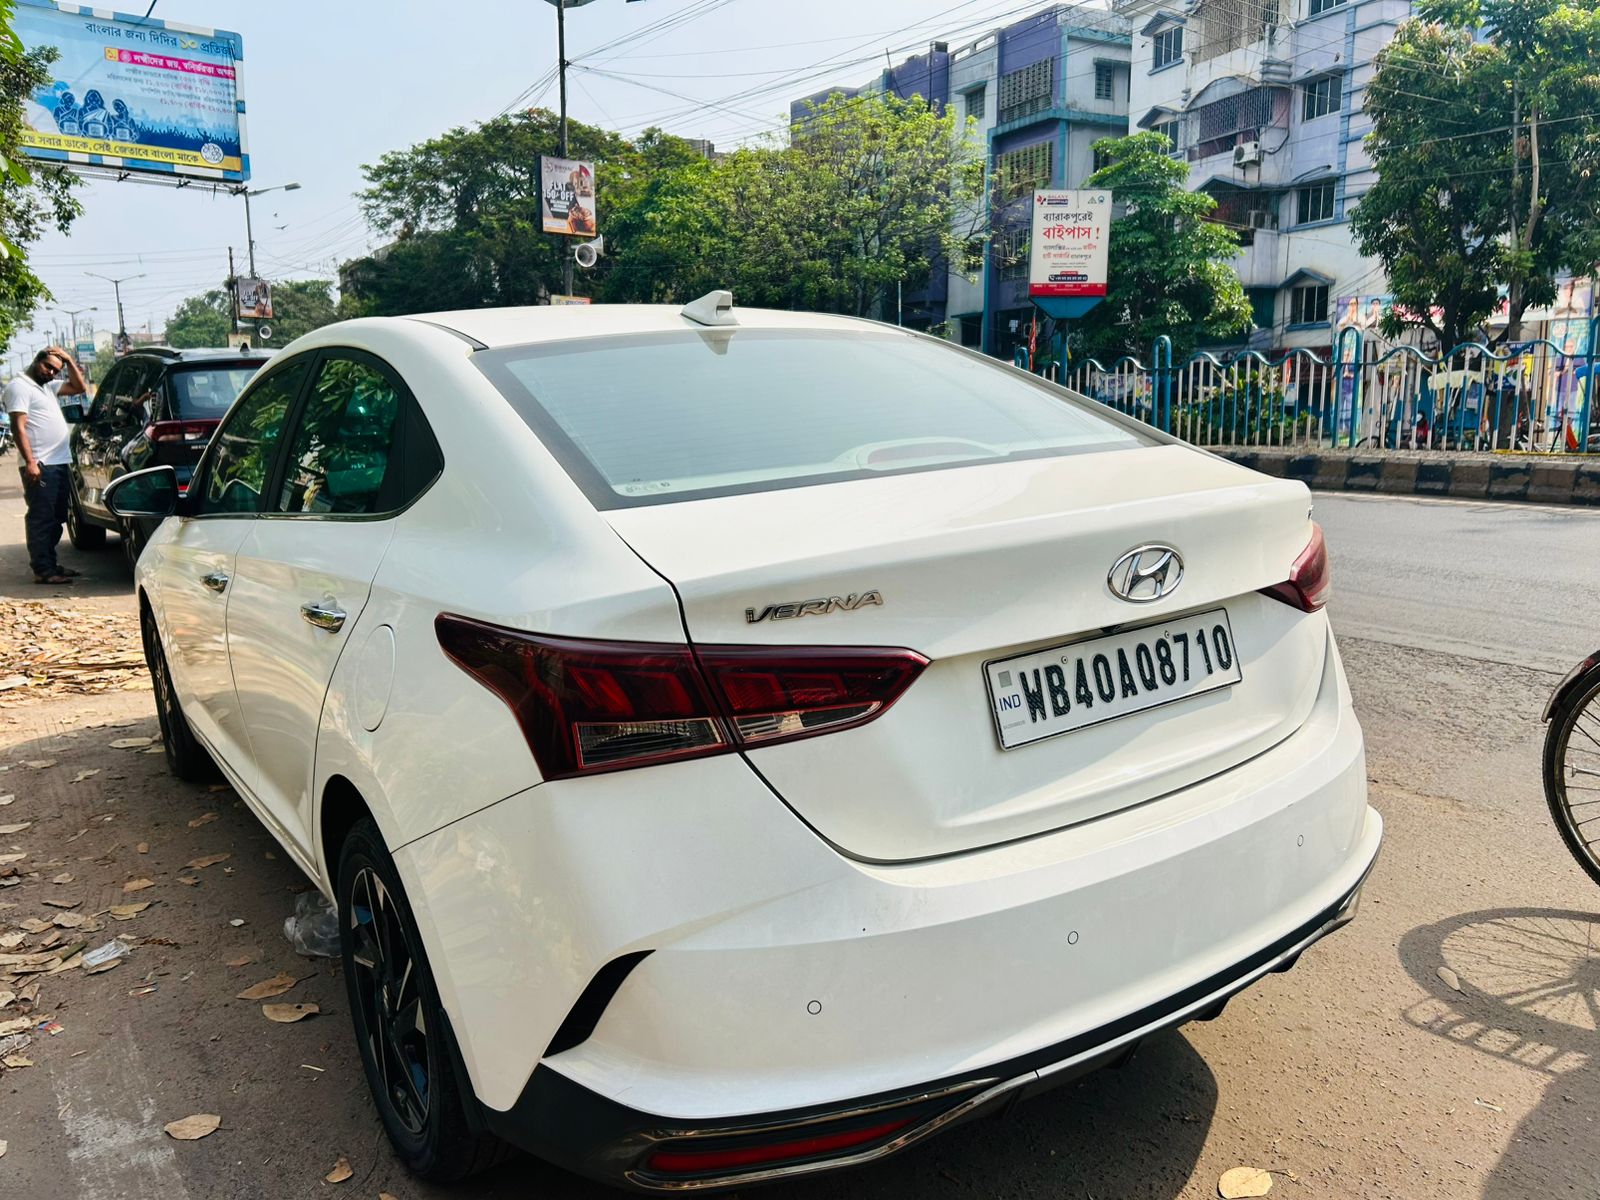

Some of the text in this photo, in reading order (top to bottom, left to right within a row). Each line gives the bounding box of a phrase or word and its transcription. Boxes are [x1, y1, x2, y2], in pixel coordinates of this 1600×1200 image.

[85, 22, 121, 38] বাংলার
[124, 28, 146, 42] জন্য
[149, 32, 177, 47] দিদির
[39, 136, 61, 147] সবার
[152, 148, 174, 160] বাংলা
[1043, 211, 1094, 224] ব্যারাকপুরেই
[1042, 224, 1092, 240] বাইপাস
[745, 589, 884, 624] VERNA
[1019, 624, 1233, 724] WB40AQ8710
[998, 693, 1022, 712] IND
